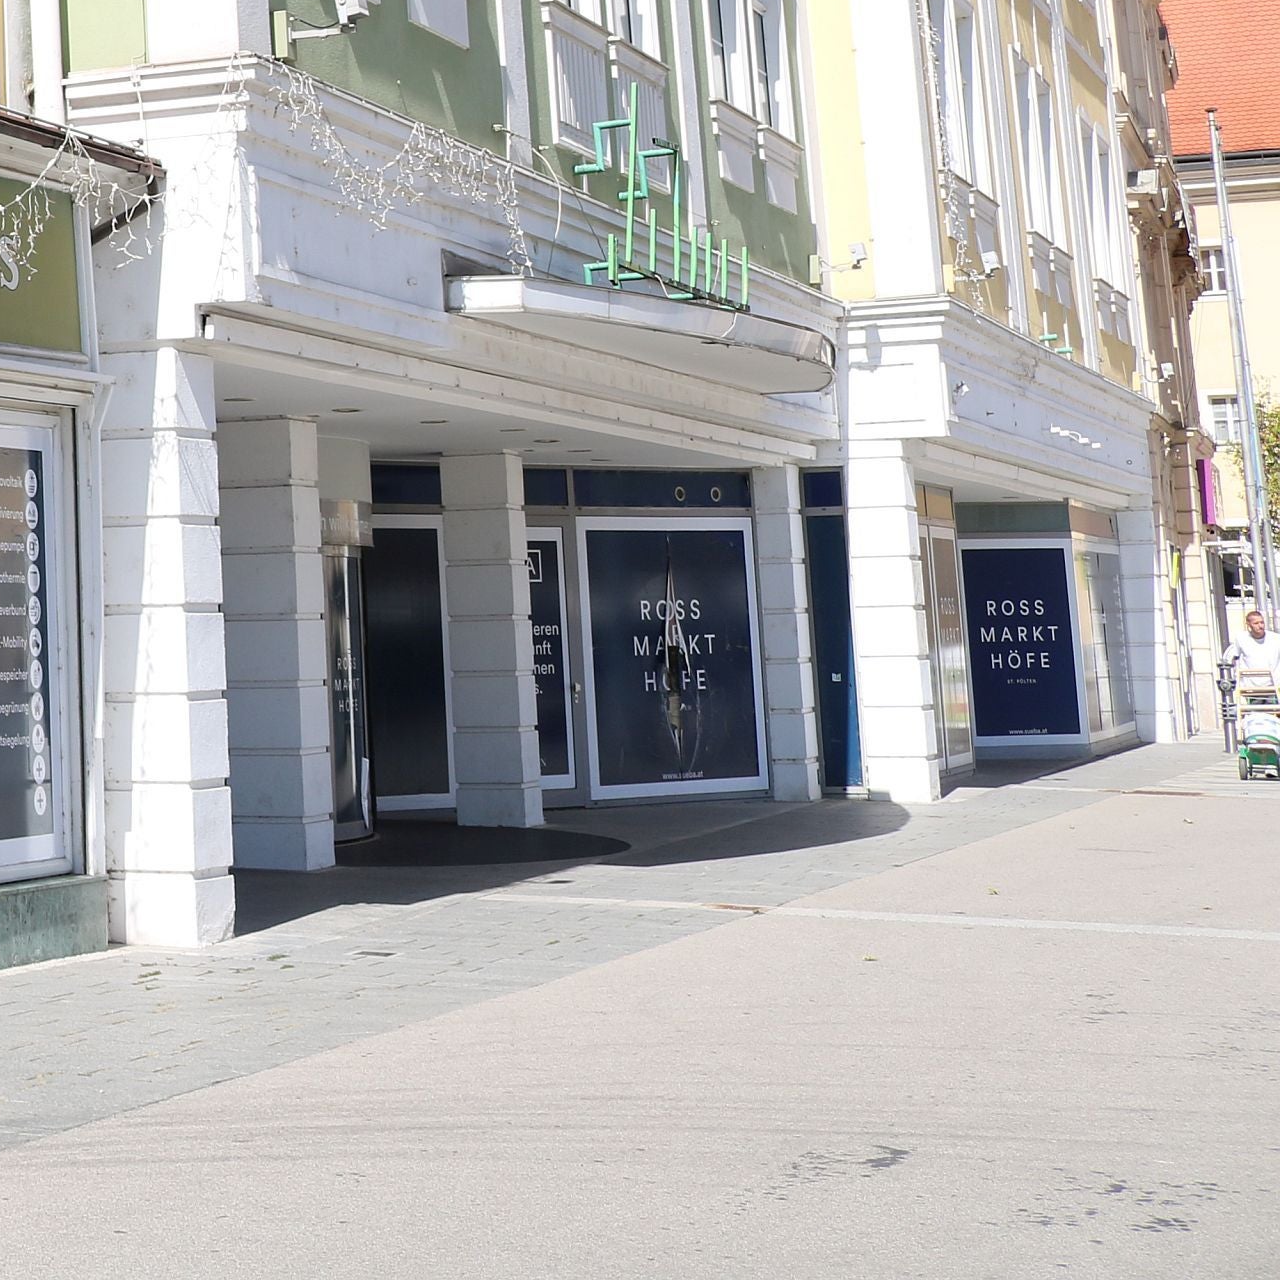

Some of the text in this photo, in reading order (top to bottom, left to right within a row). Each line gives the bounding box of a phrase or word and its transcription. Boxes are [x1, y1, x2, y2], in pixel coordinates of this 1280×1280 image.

[640, 599, 701, 621] ROSS
[986, 599, 1045, 616] ROSS
[980, 625, 1059, 643] MARKT
[990, 649, 1050, 669] HÖFE
